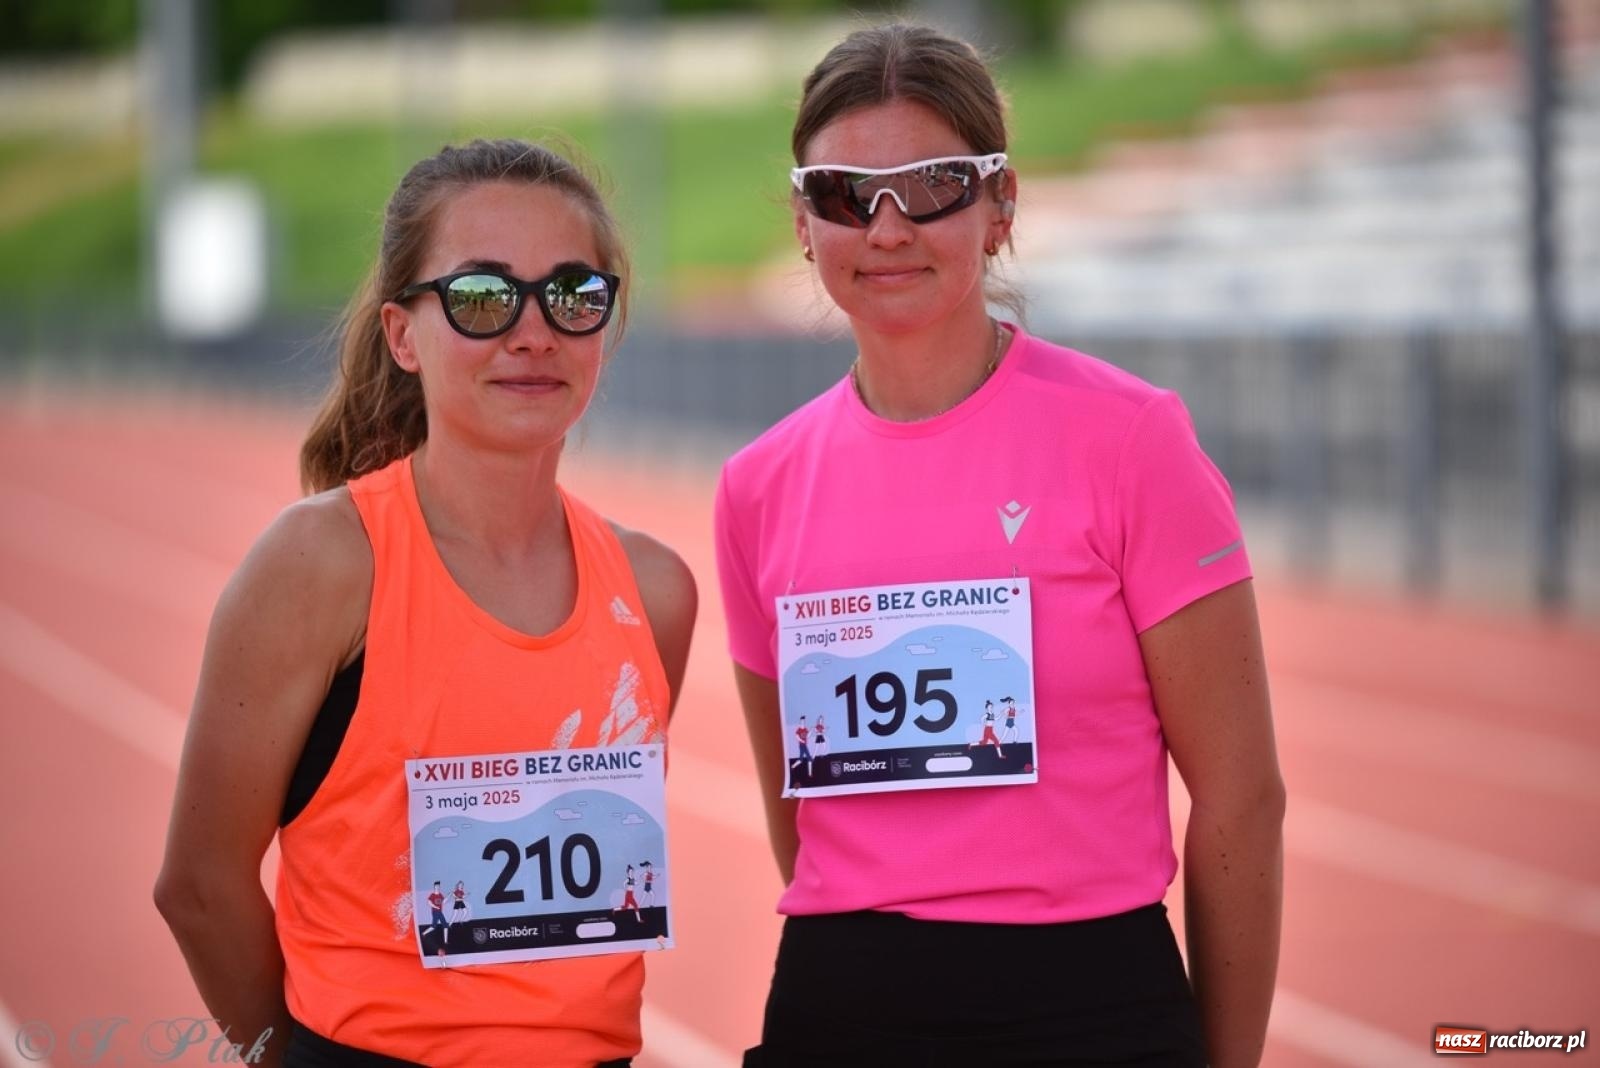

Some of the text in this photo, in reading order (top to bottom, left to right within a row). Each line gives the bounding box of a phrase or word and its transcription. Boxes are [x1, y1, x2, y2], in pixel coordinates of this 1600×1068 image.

[795, 586, 1009, 620] XVII BIEG BEZ GRANIC
[795, 625, 873, 648] 3 maja 2025
[835, 668, 958, 738] 195
[424, 751, 642, 782] XVII BIEG BEZ GRANIC
[843, 759, 887, 773] Racibórz
[425, 790, 521, 811] 3 maja 2025
[482, 833, 601, 904] 210
[489, 925, 539, 940] Racibórz
